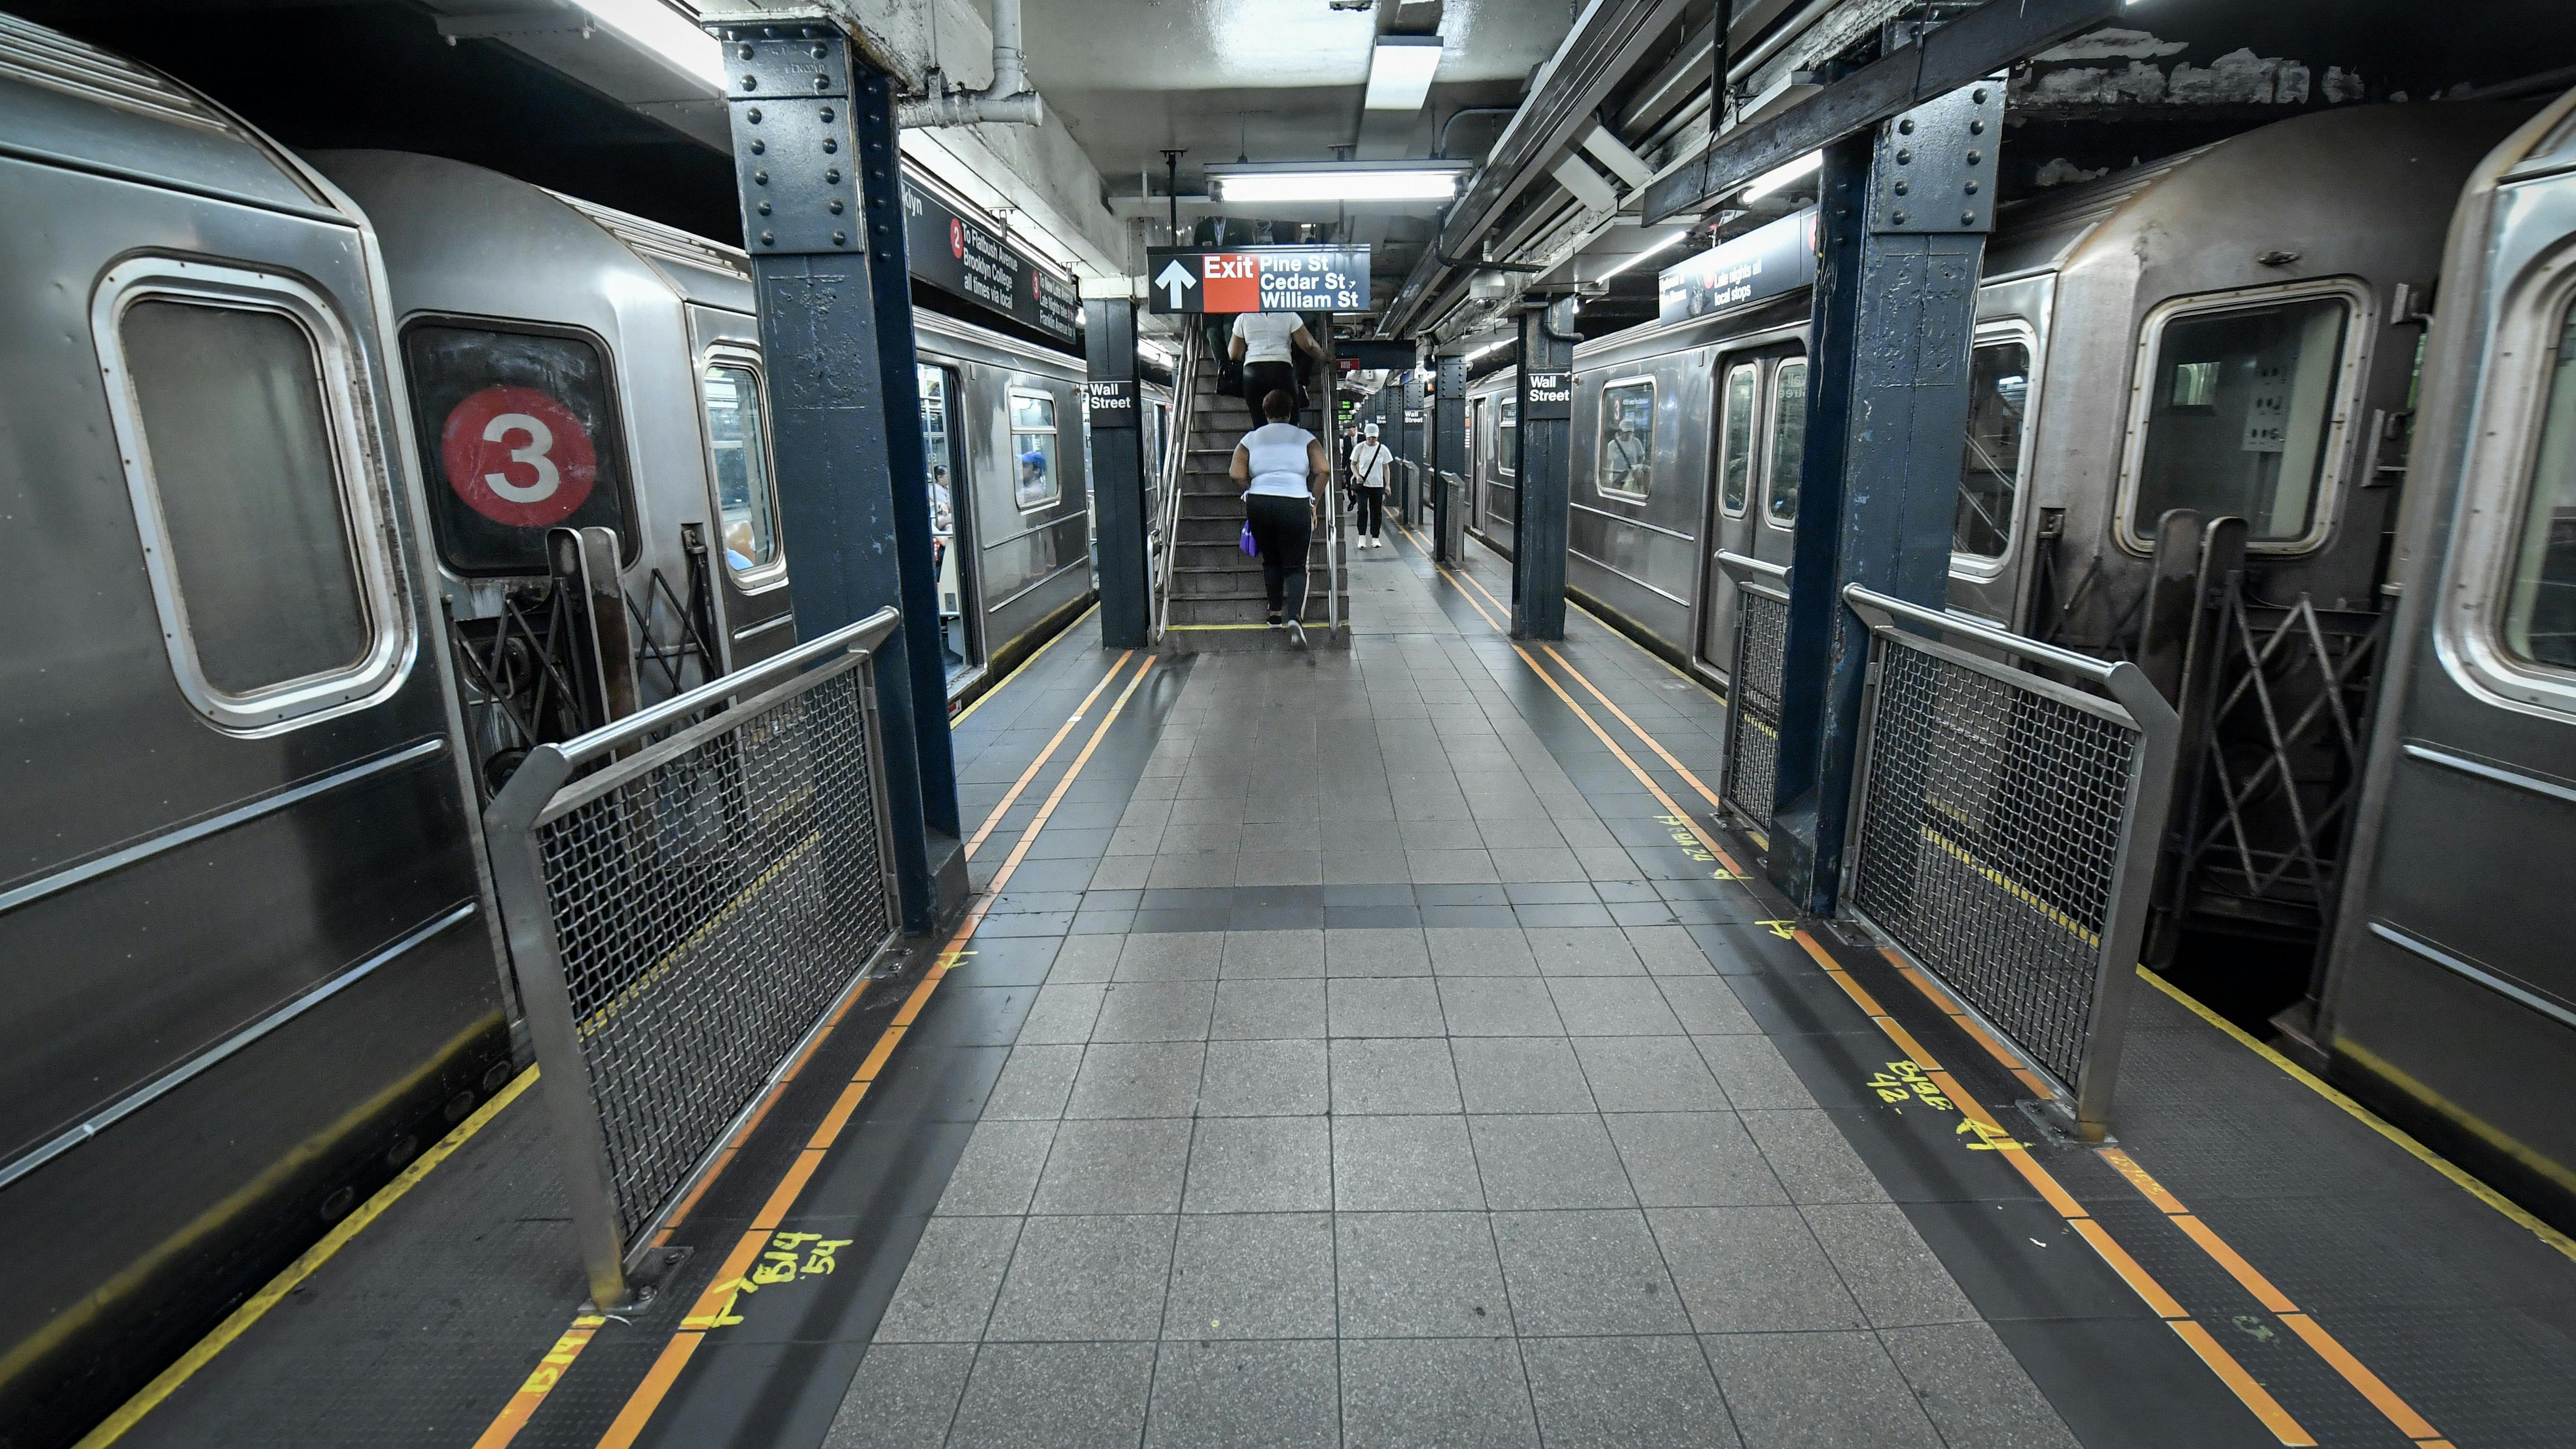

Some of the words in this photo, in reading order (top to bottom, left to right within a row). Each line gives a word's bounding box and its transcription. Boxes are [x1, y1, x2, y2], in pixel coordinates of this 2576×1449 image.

[954, 226, 960, 249] 2
[962, 222, 971, 244] To
[972, 229, 998, 261] Flatbush
[999, 246, 1018, 272] Avenue
[964, 247, 991, 280] Brooklyn
[992, 263, 1012, 291] College
[1204, 256, 1253, 279] Exit
[1260, 257, 1302, 272] Pine
[1308, 256, 1329, 271] St
[1714, 272, 1729, 288] Late
[1729, 264, 1752, 285] nights
[1753, 258, 1762, 276] all
[964, 272, 973, 291] all
[973, 276, 990, 299] times
[991, 286, 999, 304] via
[1000, 289, 1013, 310] local
[1034, 277, 1038, 294] 3
[1039, 272, 1045, 288] To
[1053, 281, 1061, 298] Lots
[1260, 273, 1320, 290] Cedar
[1325, 273, 1346, 289] St
[1039, 291, 1048, 308] Late
[1261, 292, 1331, 308] William
[1338, 291, 1358, 307] St
[1714, 288, 1731, 306] local
[1731, 284, 1751, 302] stops
[1090, 384, 1119, 396] Wall
[1530, 376, 1556, 388] Wall
[1091, 396, 1131, 409] Street
[1529, 389, 1570, 402] Street
[483, 413, 560, 504] 3
